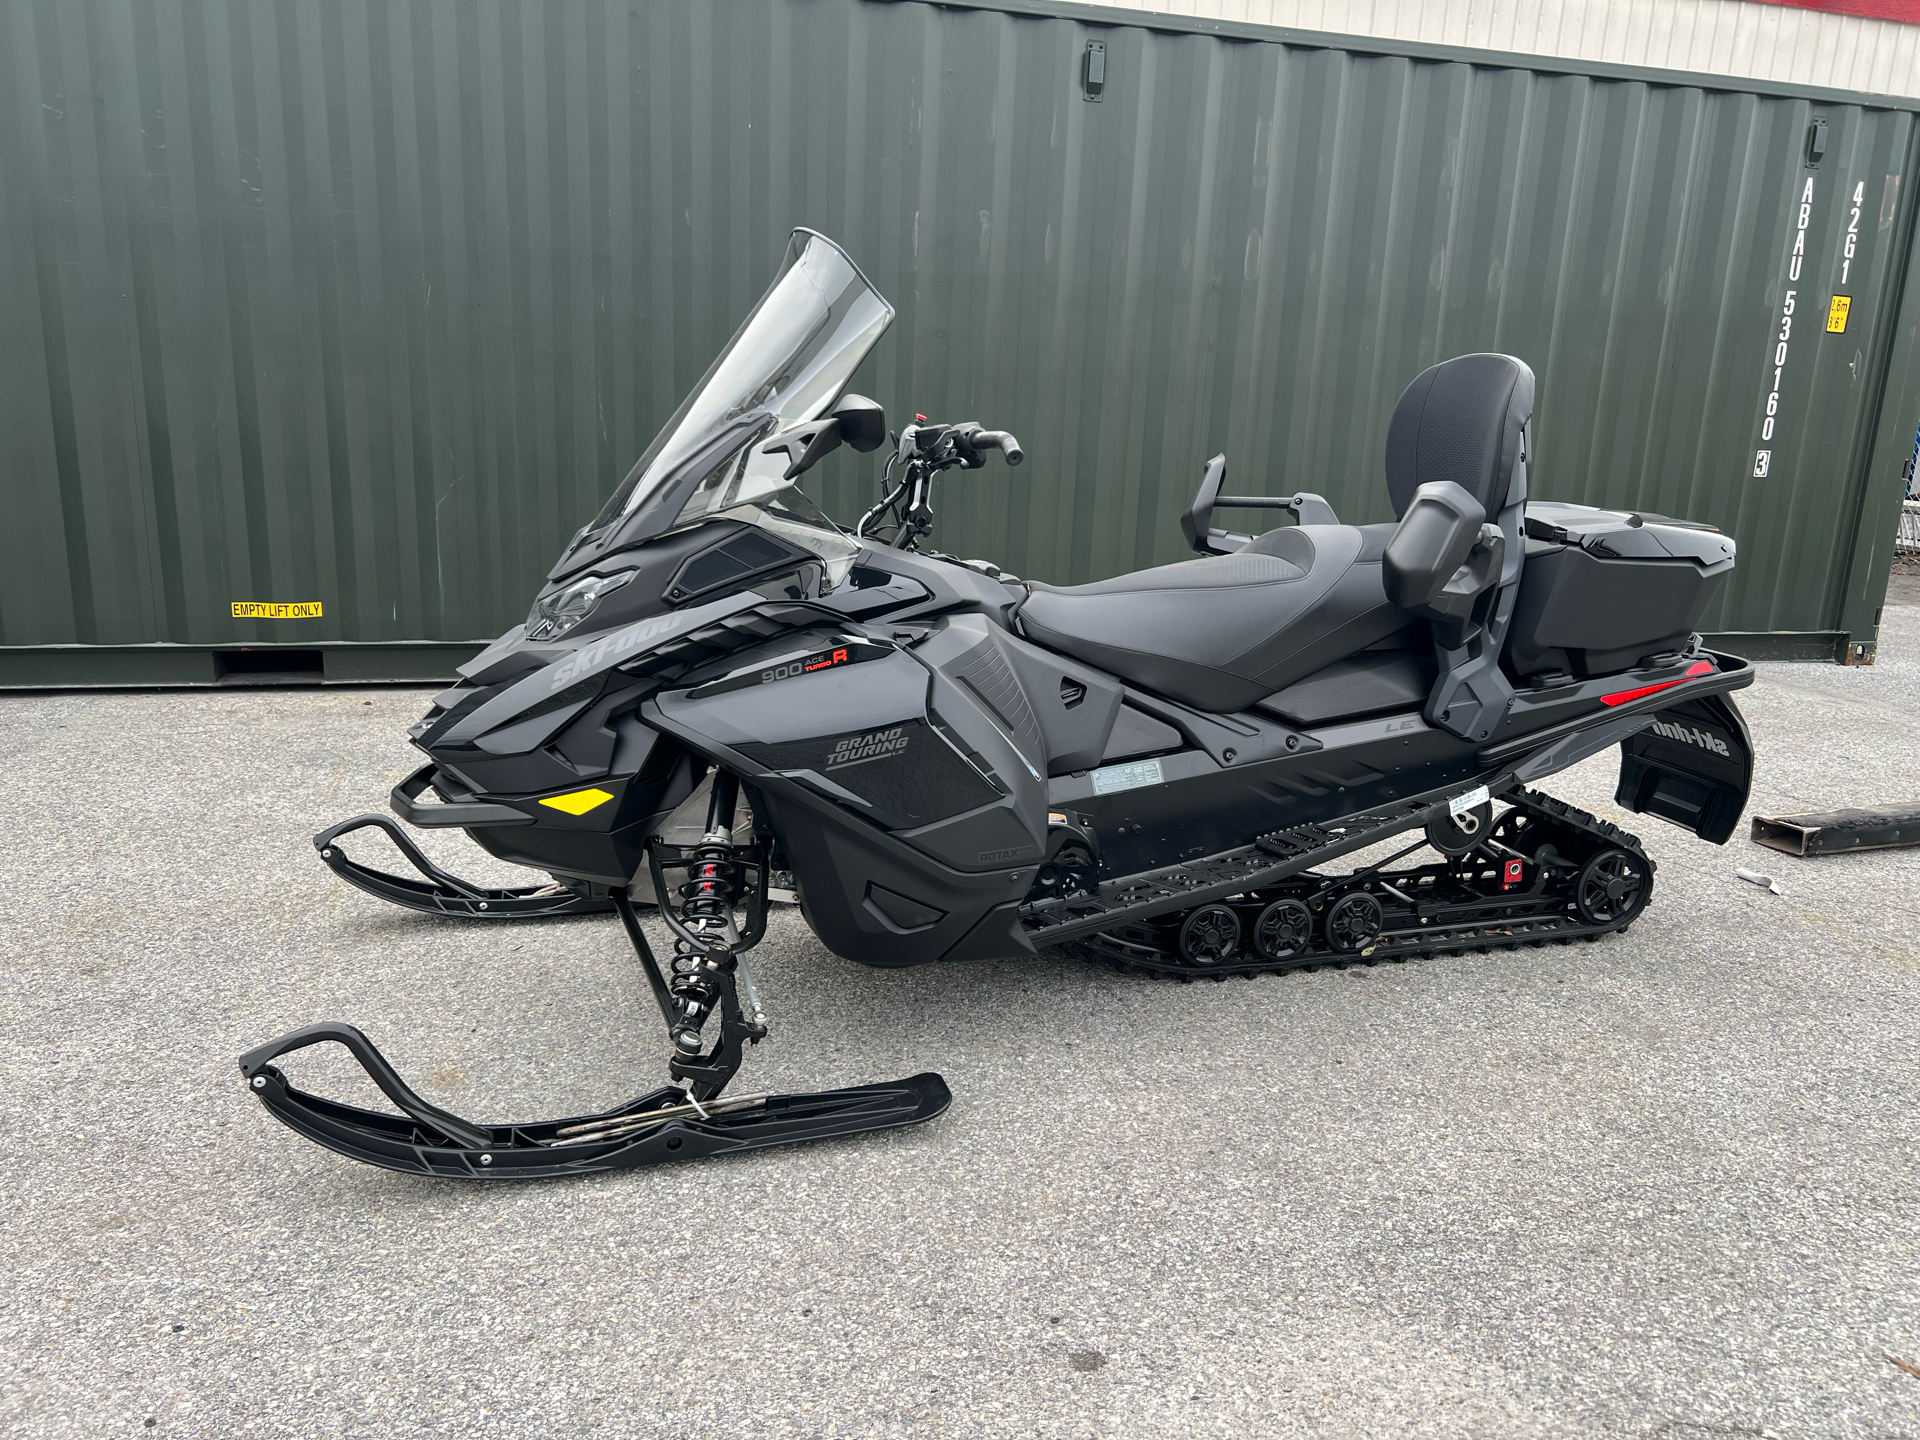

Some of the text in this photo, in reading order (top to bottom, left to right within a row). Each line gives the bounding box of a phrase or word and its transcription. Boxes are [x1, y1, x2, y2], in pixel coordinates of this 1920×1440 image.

[1841, 181, 1864, 285] 42G1
[1755, 177, 1814, 476] ABAU 530160 3
[233, 603, 320, 617] EMPTY LIFT ONLY
[805, 655, 825, 666] ACE
[833, 648, 848, 664] R
[761, 662, 803, 684] 900
[805, 660, 832, 672] TURBO
[1384, 719, 1416, 733] LE
[835, 728, 902, 752] GRAND
[827, 737, 909, 765] TOURING
[980, 848, 1019, 862] ROTAX
